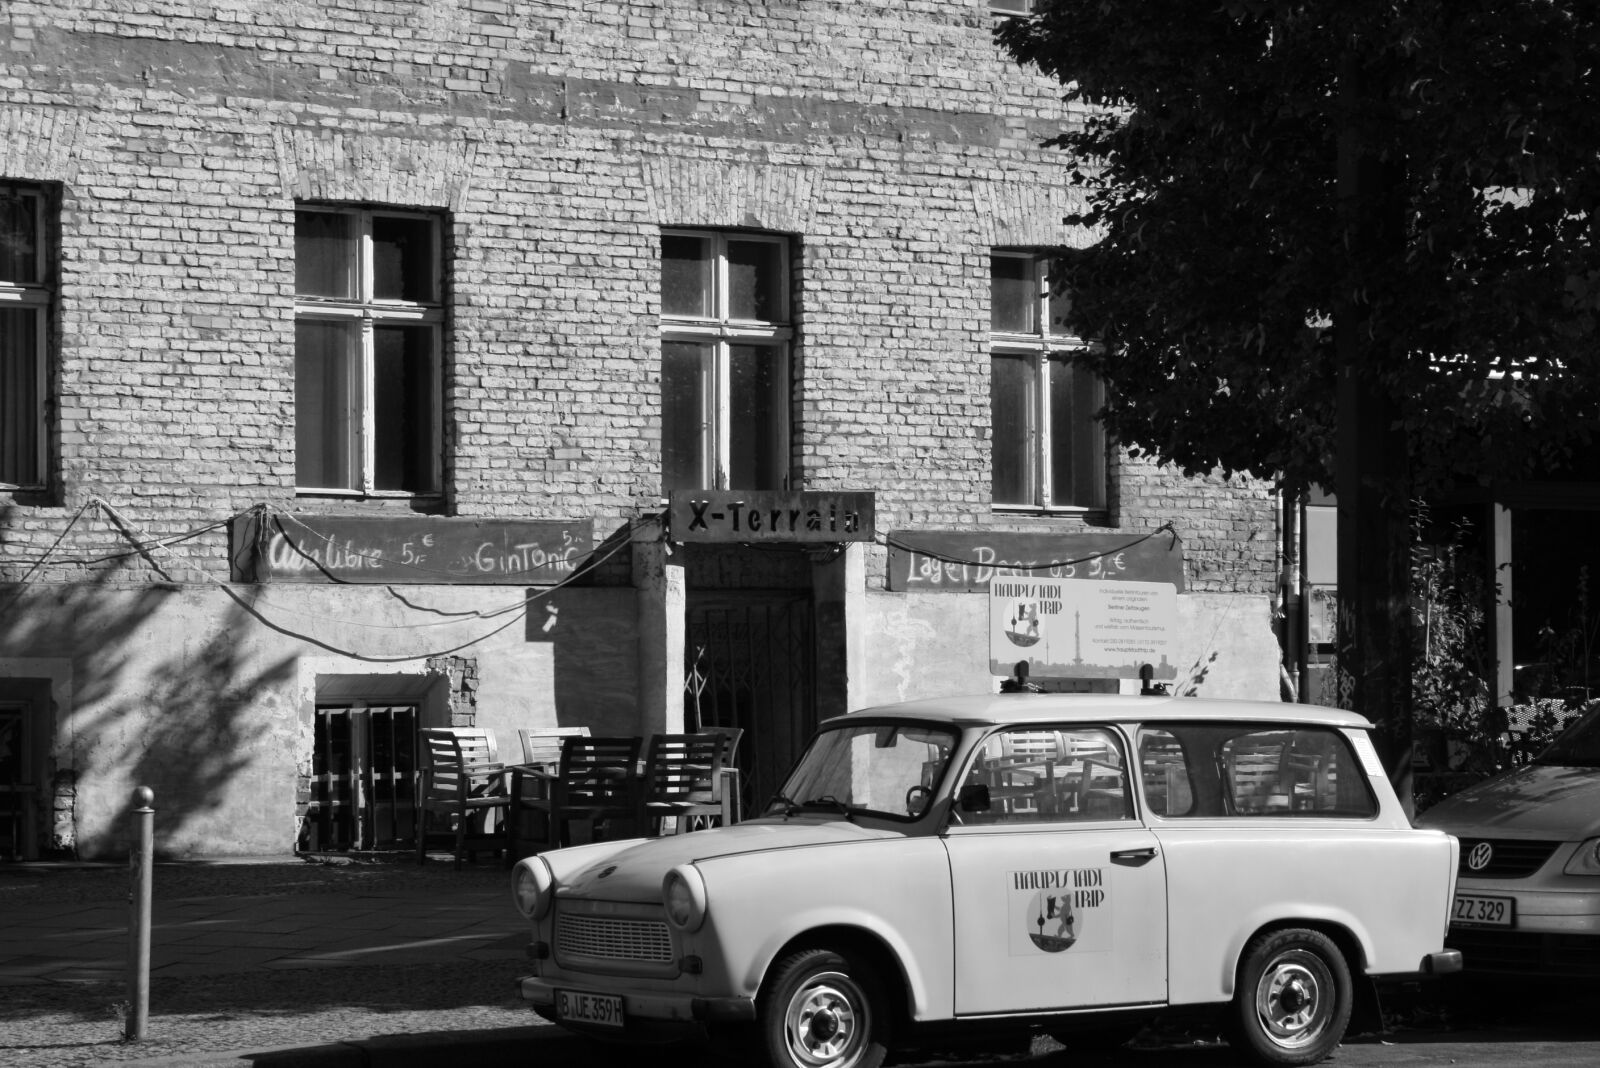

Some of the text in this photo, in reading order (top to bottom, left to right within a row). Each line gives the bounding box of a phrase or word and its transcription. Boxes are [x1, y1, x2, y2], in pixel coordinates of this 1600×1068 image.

[688, 500, 859, 532] X-Terrain
[1039, 601, 1063, 615] TRIP
[1075, 889, 1105, 908] TRIP
[1456, 899, 1505, 921] ZZ 329
